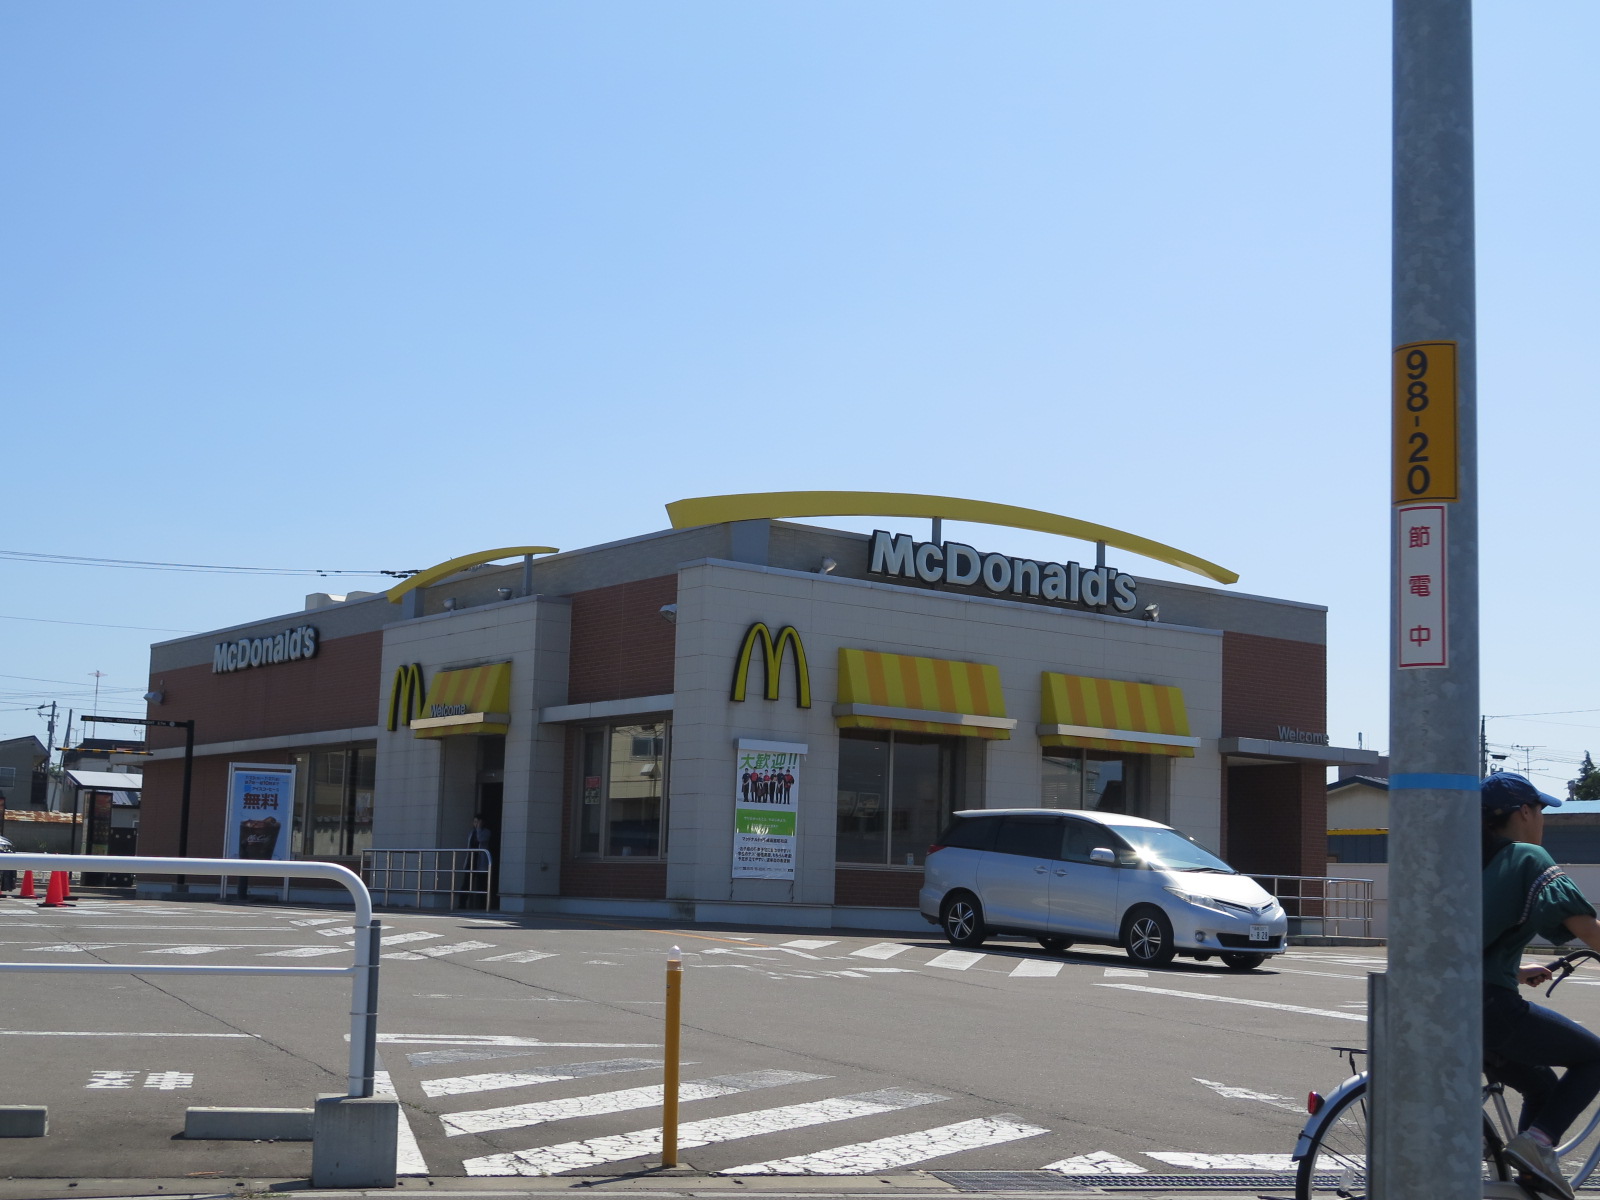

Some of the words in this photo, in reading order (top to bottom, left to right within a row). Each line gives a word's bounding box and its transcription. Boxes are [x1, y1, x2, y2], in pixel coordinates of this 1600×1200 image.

[1406, 350, 1431, 495] 98-20
[868, 529, 1138, 613] McDonald's
[1408, 525, 1431, 648] 節電中
[212, 625, 318, 675] McDonald's
[430, 703, 467, 717] Welcome
[1278, 725, 1329, 745] Welcome
[242, 792, 279, 810] 無料
